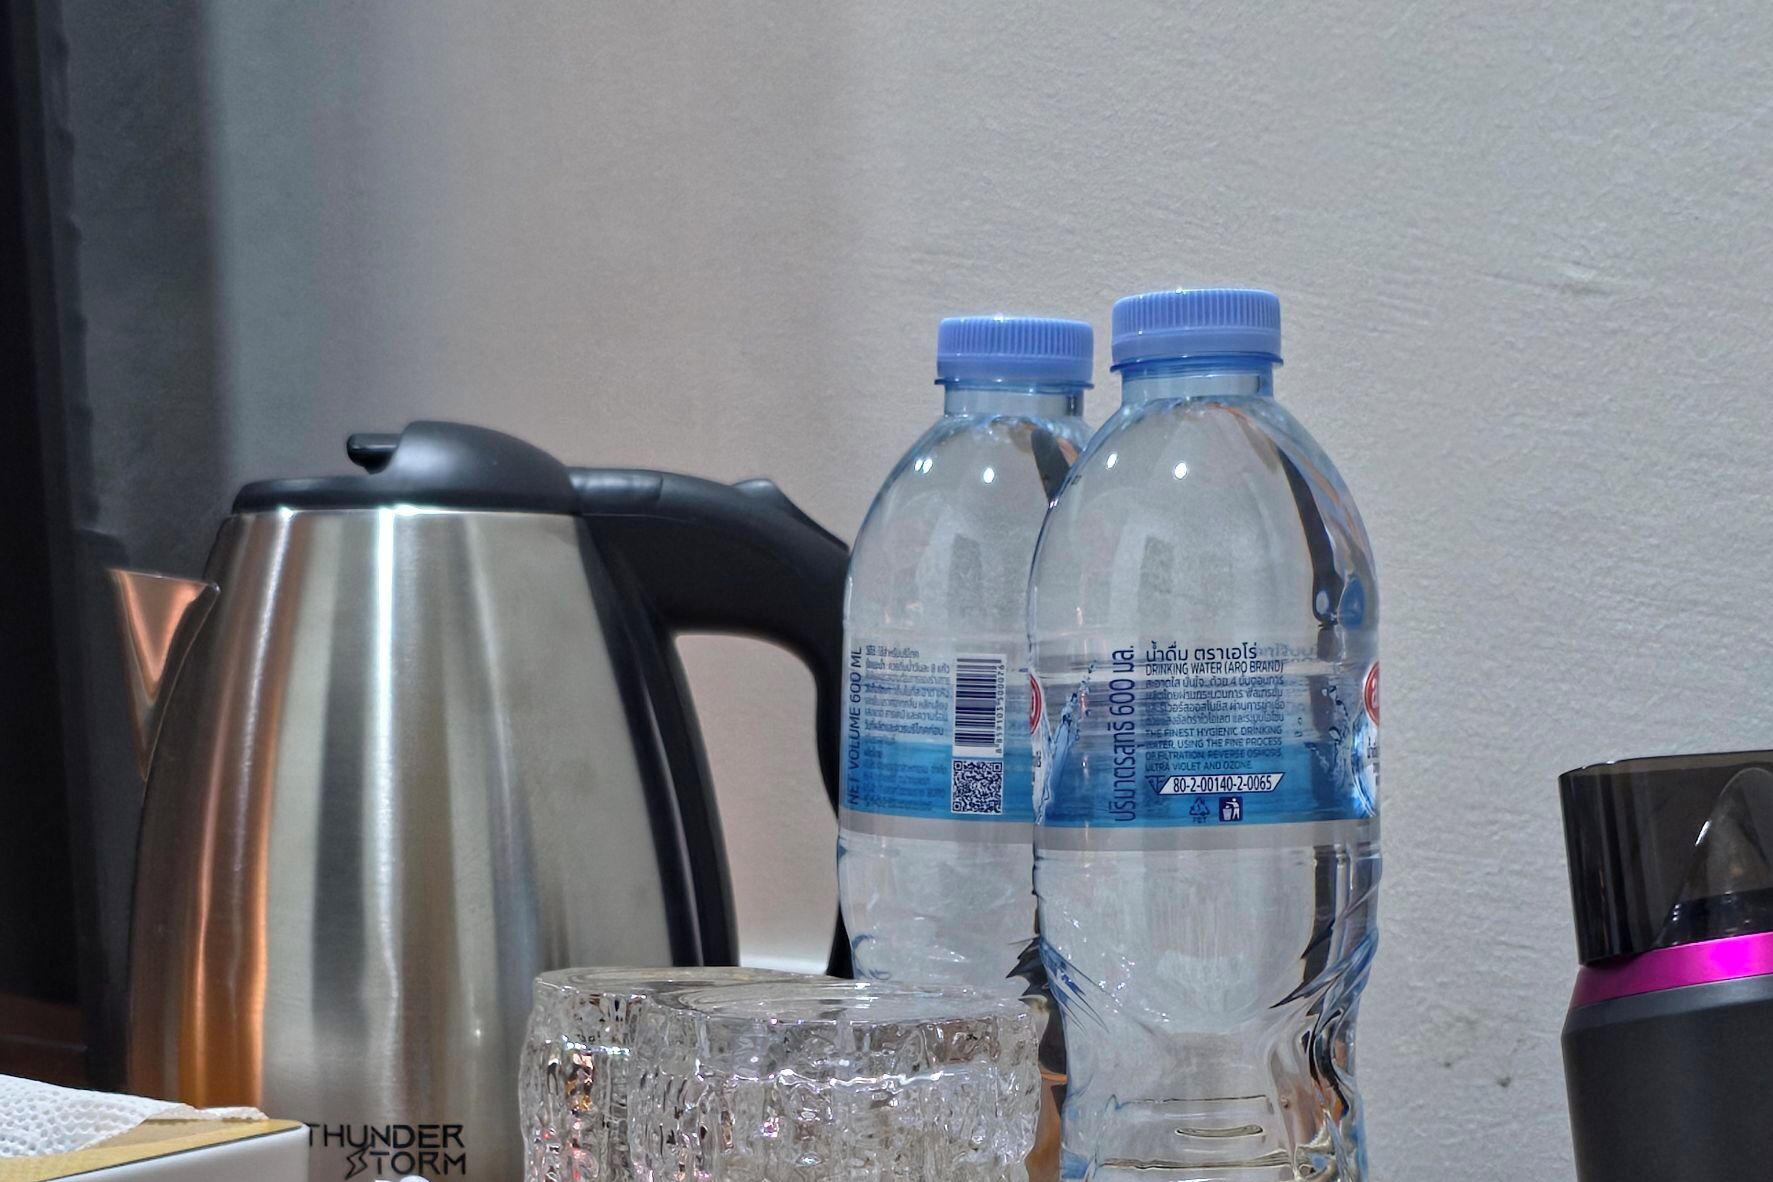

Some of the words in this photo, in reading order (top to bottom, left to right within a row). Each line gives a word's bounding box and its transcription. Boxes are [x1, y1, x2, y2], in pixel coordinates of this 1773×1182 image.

[851, 647, 862, 668] ML
[1112, 645, 1135, 673] มล.
[1146, 640, 1188, 662] น้ำดื่ม
[1194, 642, 1257, 660] ตราเอโร่
[1146, 663, 1188, 676] DRINKING
[1191, 662, 1222, 674] WATER
[1250, 660, 1283, 674] BRAND)
[850, 672, 862, 703] 600
[1109, 678, 1135, 716] 600
[848, 709, 860, 770] VOLUME
[1164, 729, 1194, 738] FINEST
[1197, 728, 1239, 737] HYGIENIC
[1241, 726, 1281, 735] DRINKING
[1178, 740, 1204, 749] USING
[1206, 739, 1221, 747] THE
[1224, 739, 1243, 747] FINE
[1246, 738, 1281, 746] PROCESS
[1107, 721, 1144, 822] ปริมาตรสุทธิ
[1173, 762, 1201, 771] VIOLET
[1203, 761, 1221, 770] AND
[847, 774, 860, 805] NET
[1173, 775, 1272, 793] 80-2-00140-2-0065
[303, 1124, 465, 1148] THUNDER
